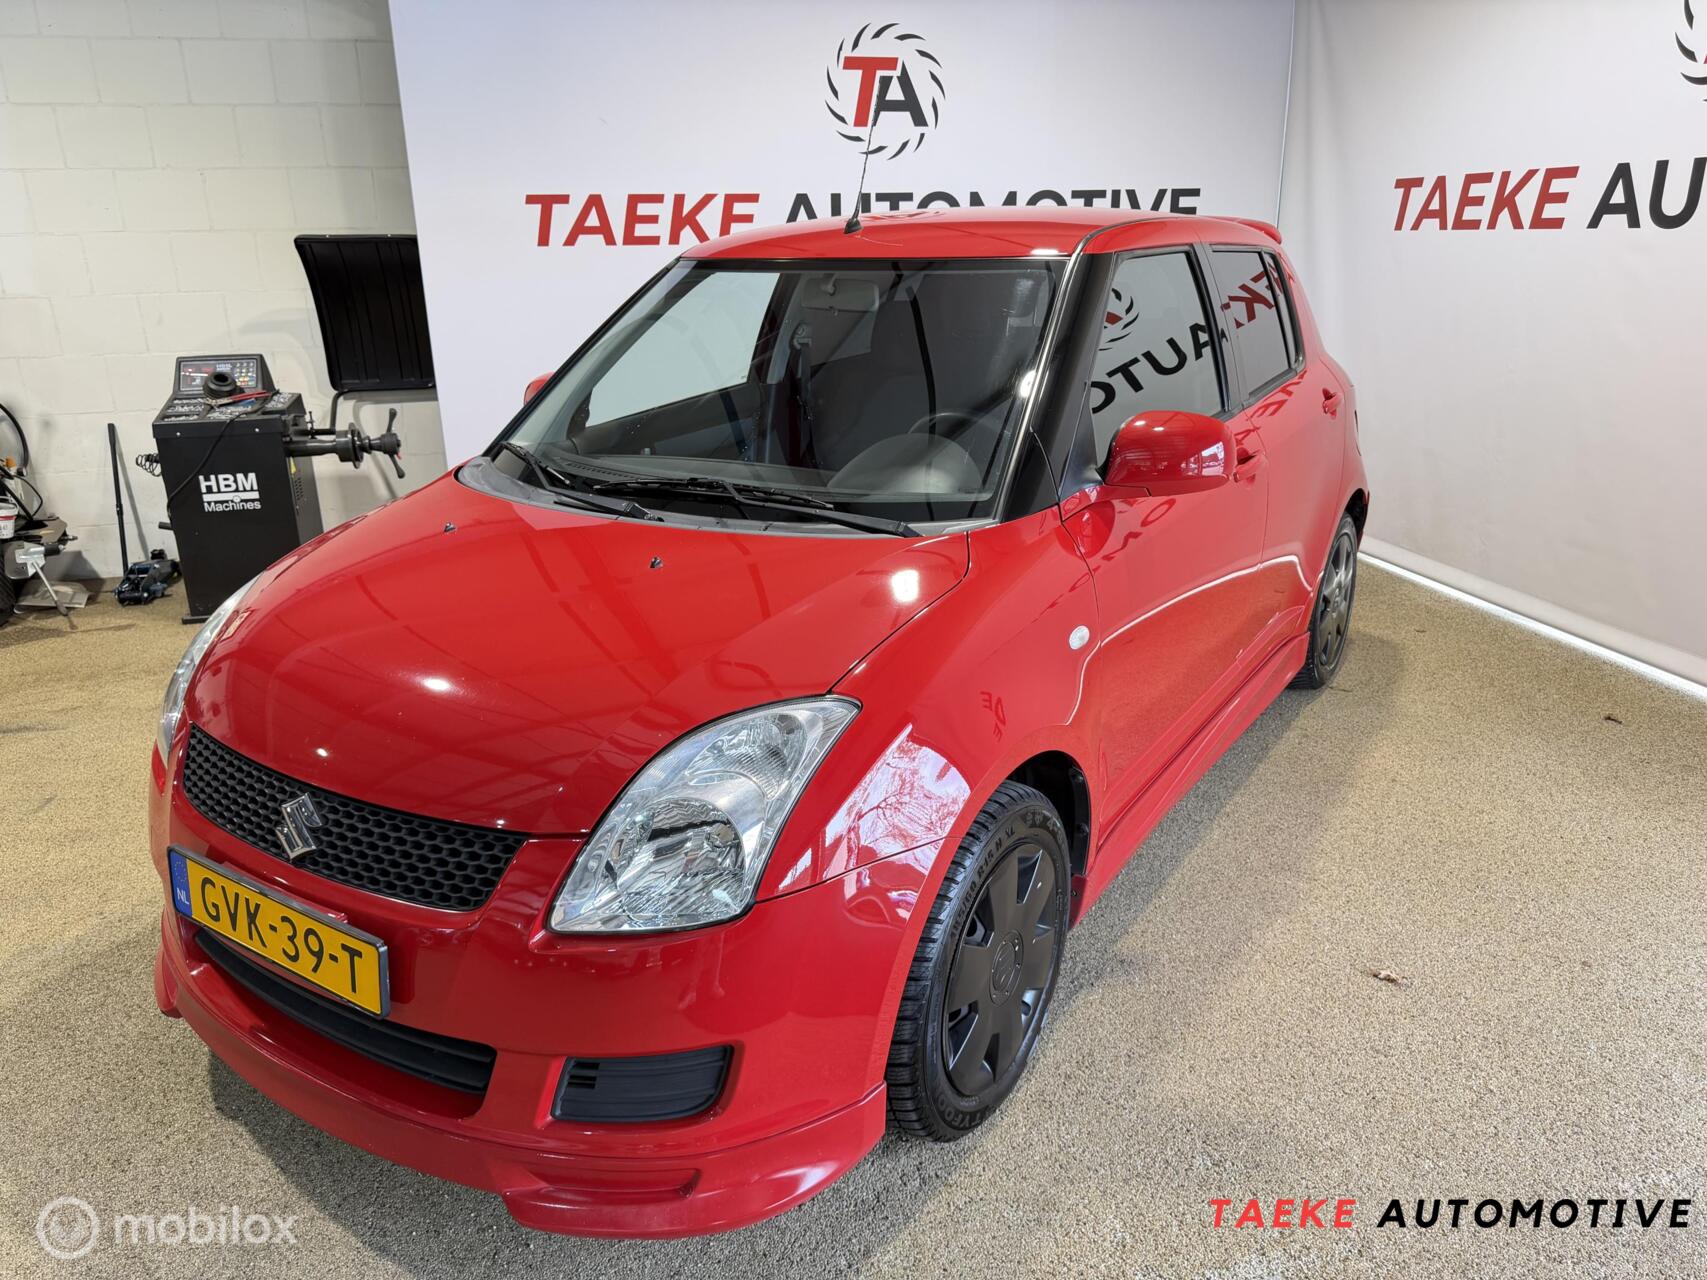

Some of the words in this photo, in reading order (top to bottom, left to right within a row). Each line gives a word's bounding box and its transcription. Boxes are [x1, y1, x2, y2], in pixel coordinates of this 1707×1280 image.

[843, 56, 929, 127] TA
[1394, 166, 1580, 231] TAEKE
[198, 472, 259, 493] HBM
[204, 500, 261, 513] Machines
[176, 887, 190, 905] NL
[201, 876, 363, 994] GVK-39-T
